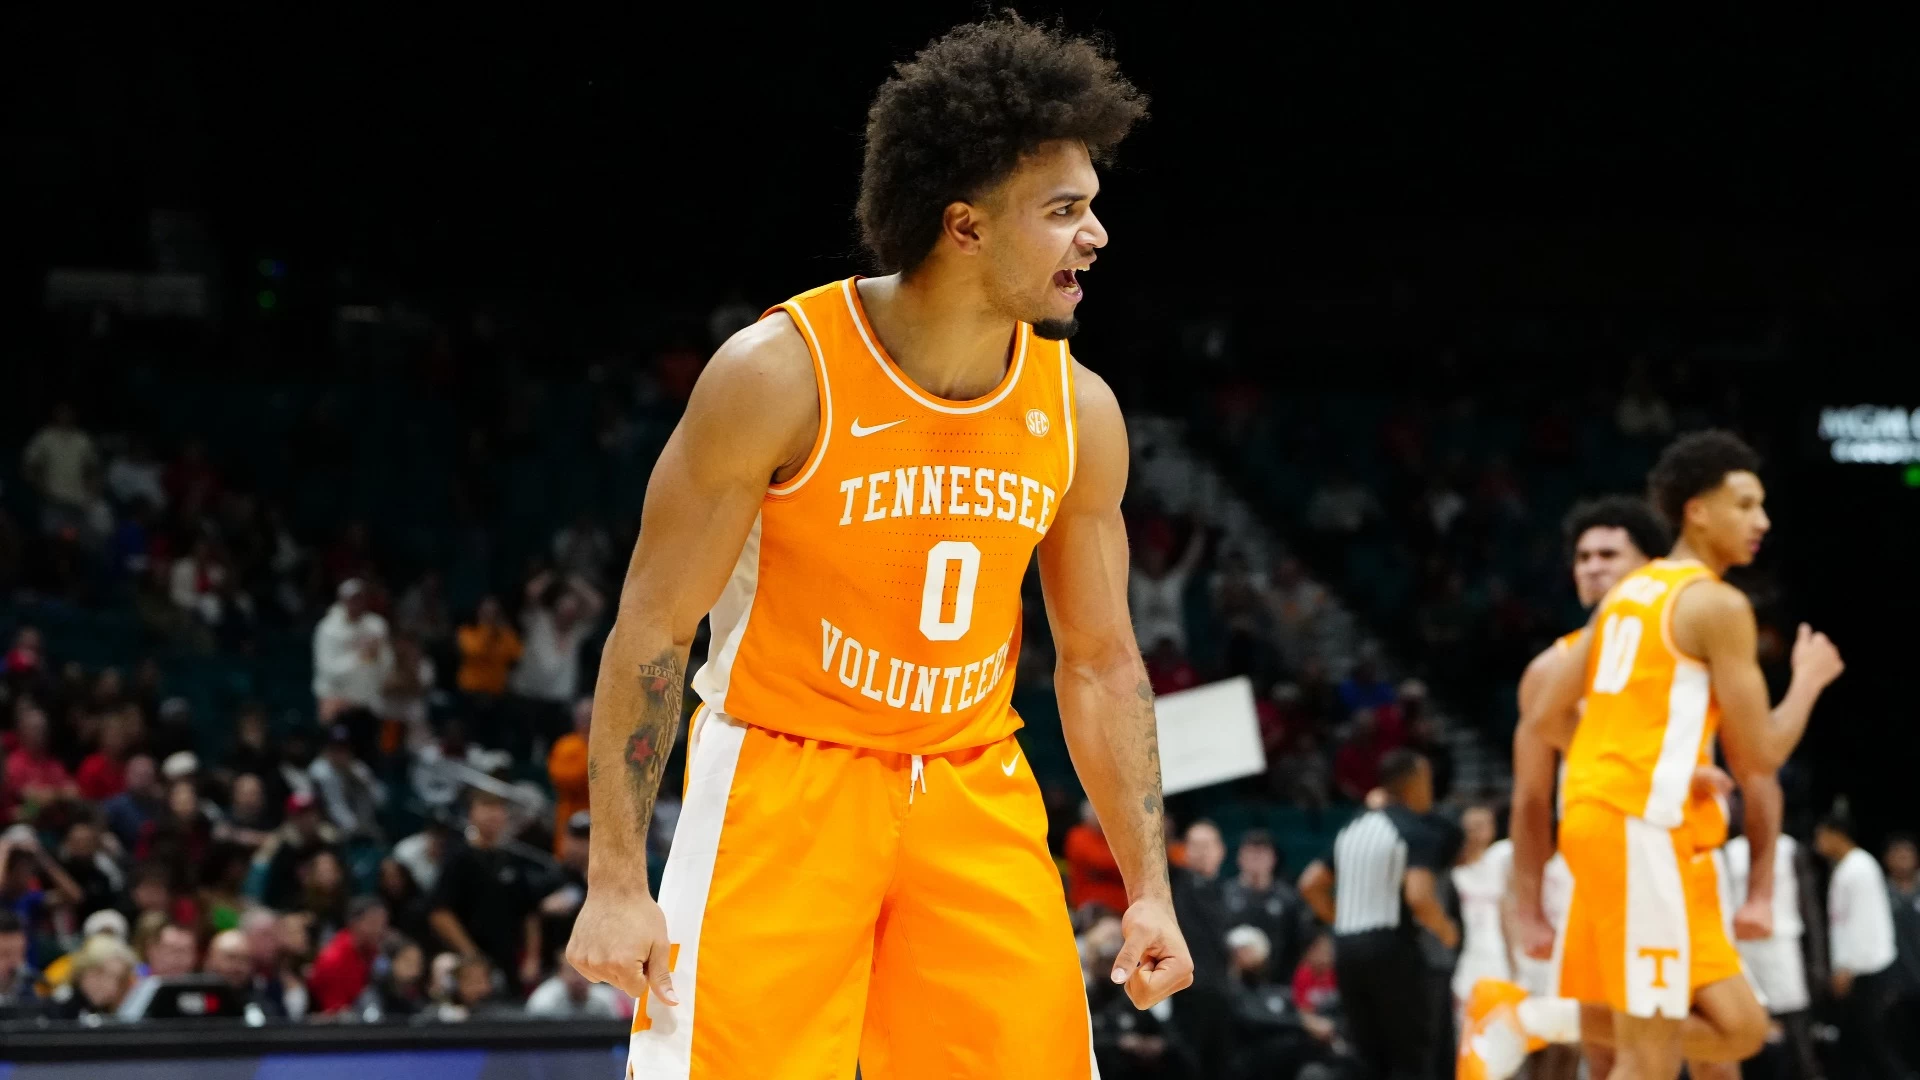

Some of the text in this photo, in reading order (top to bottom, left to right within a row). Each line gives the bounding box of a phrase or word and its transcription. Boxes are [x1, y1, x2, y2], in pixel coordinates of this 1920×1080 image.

[1027, 410, 1049, 435] SEC
[839, 465, 1055, 535] TENNESSEE
[919, 541, 981, 641] 0
[1638, 947, 1679, 988] T
